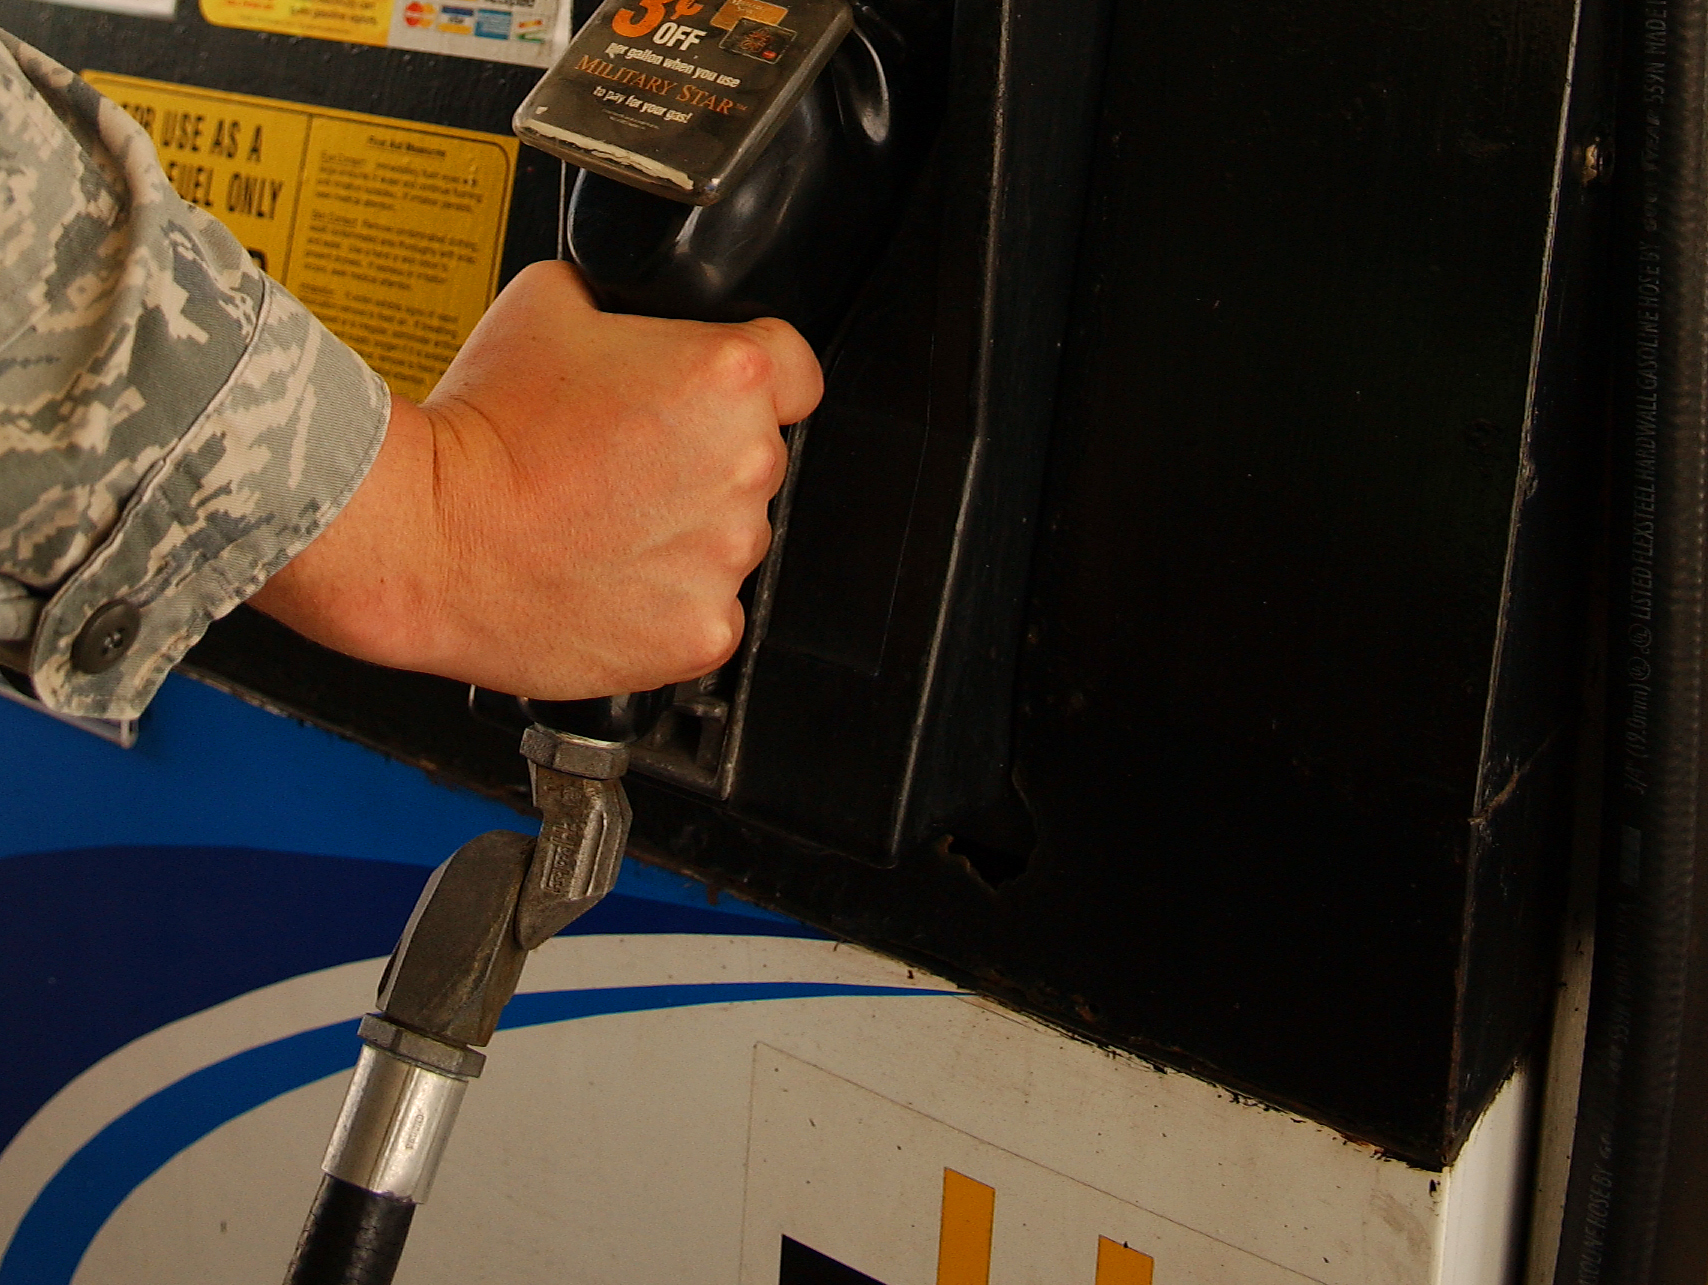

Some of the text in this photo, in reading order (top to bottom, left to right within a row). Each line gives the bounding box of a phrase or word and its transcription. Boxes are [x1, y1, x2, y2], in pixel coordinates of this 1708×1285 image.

[652, 21, 708, 51] OFF
[1644, 8, 1668, 55] MADE
[574, 54, 679, 97] MILITARY
[624, 45, 664, 66] gallon
[662, 57, 696, 75] when
[691, 66, 718, 82] you
[716, 75, 742, 89] use
[592, 85, 604, 99] to
[604, 89, 627, 105] pay
[625, 94, 641, 109] for
[638, 102, 668, 117] your
[663, 107, 694, 124] gas!
[160, 111, 263, 163] USE AS A
[226, 171, 284, 221] ONLY
[1639, 240, 1661, 261] BY
[1638, 265, 1660, 308] HOSE
[1636, 309, 1660, 391] GASOLINE
[1635, 392, 1658, 481] HARDWALL
[1632, 483, 1655, 565] FLEXSTEEL
[1630, 565, 1653, 620] LISTED
